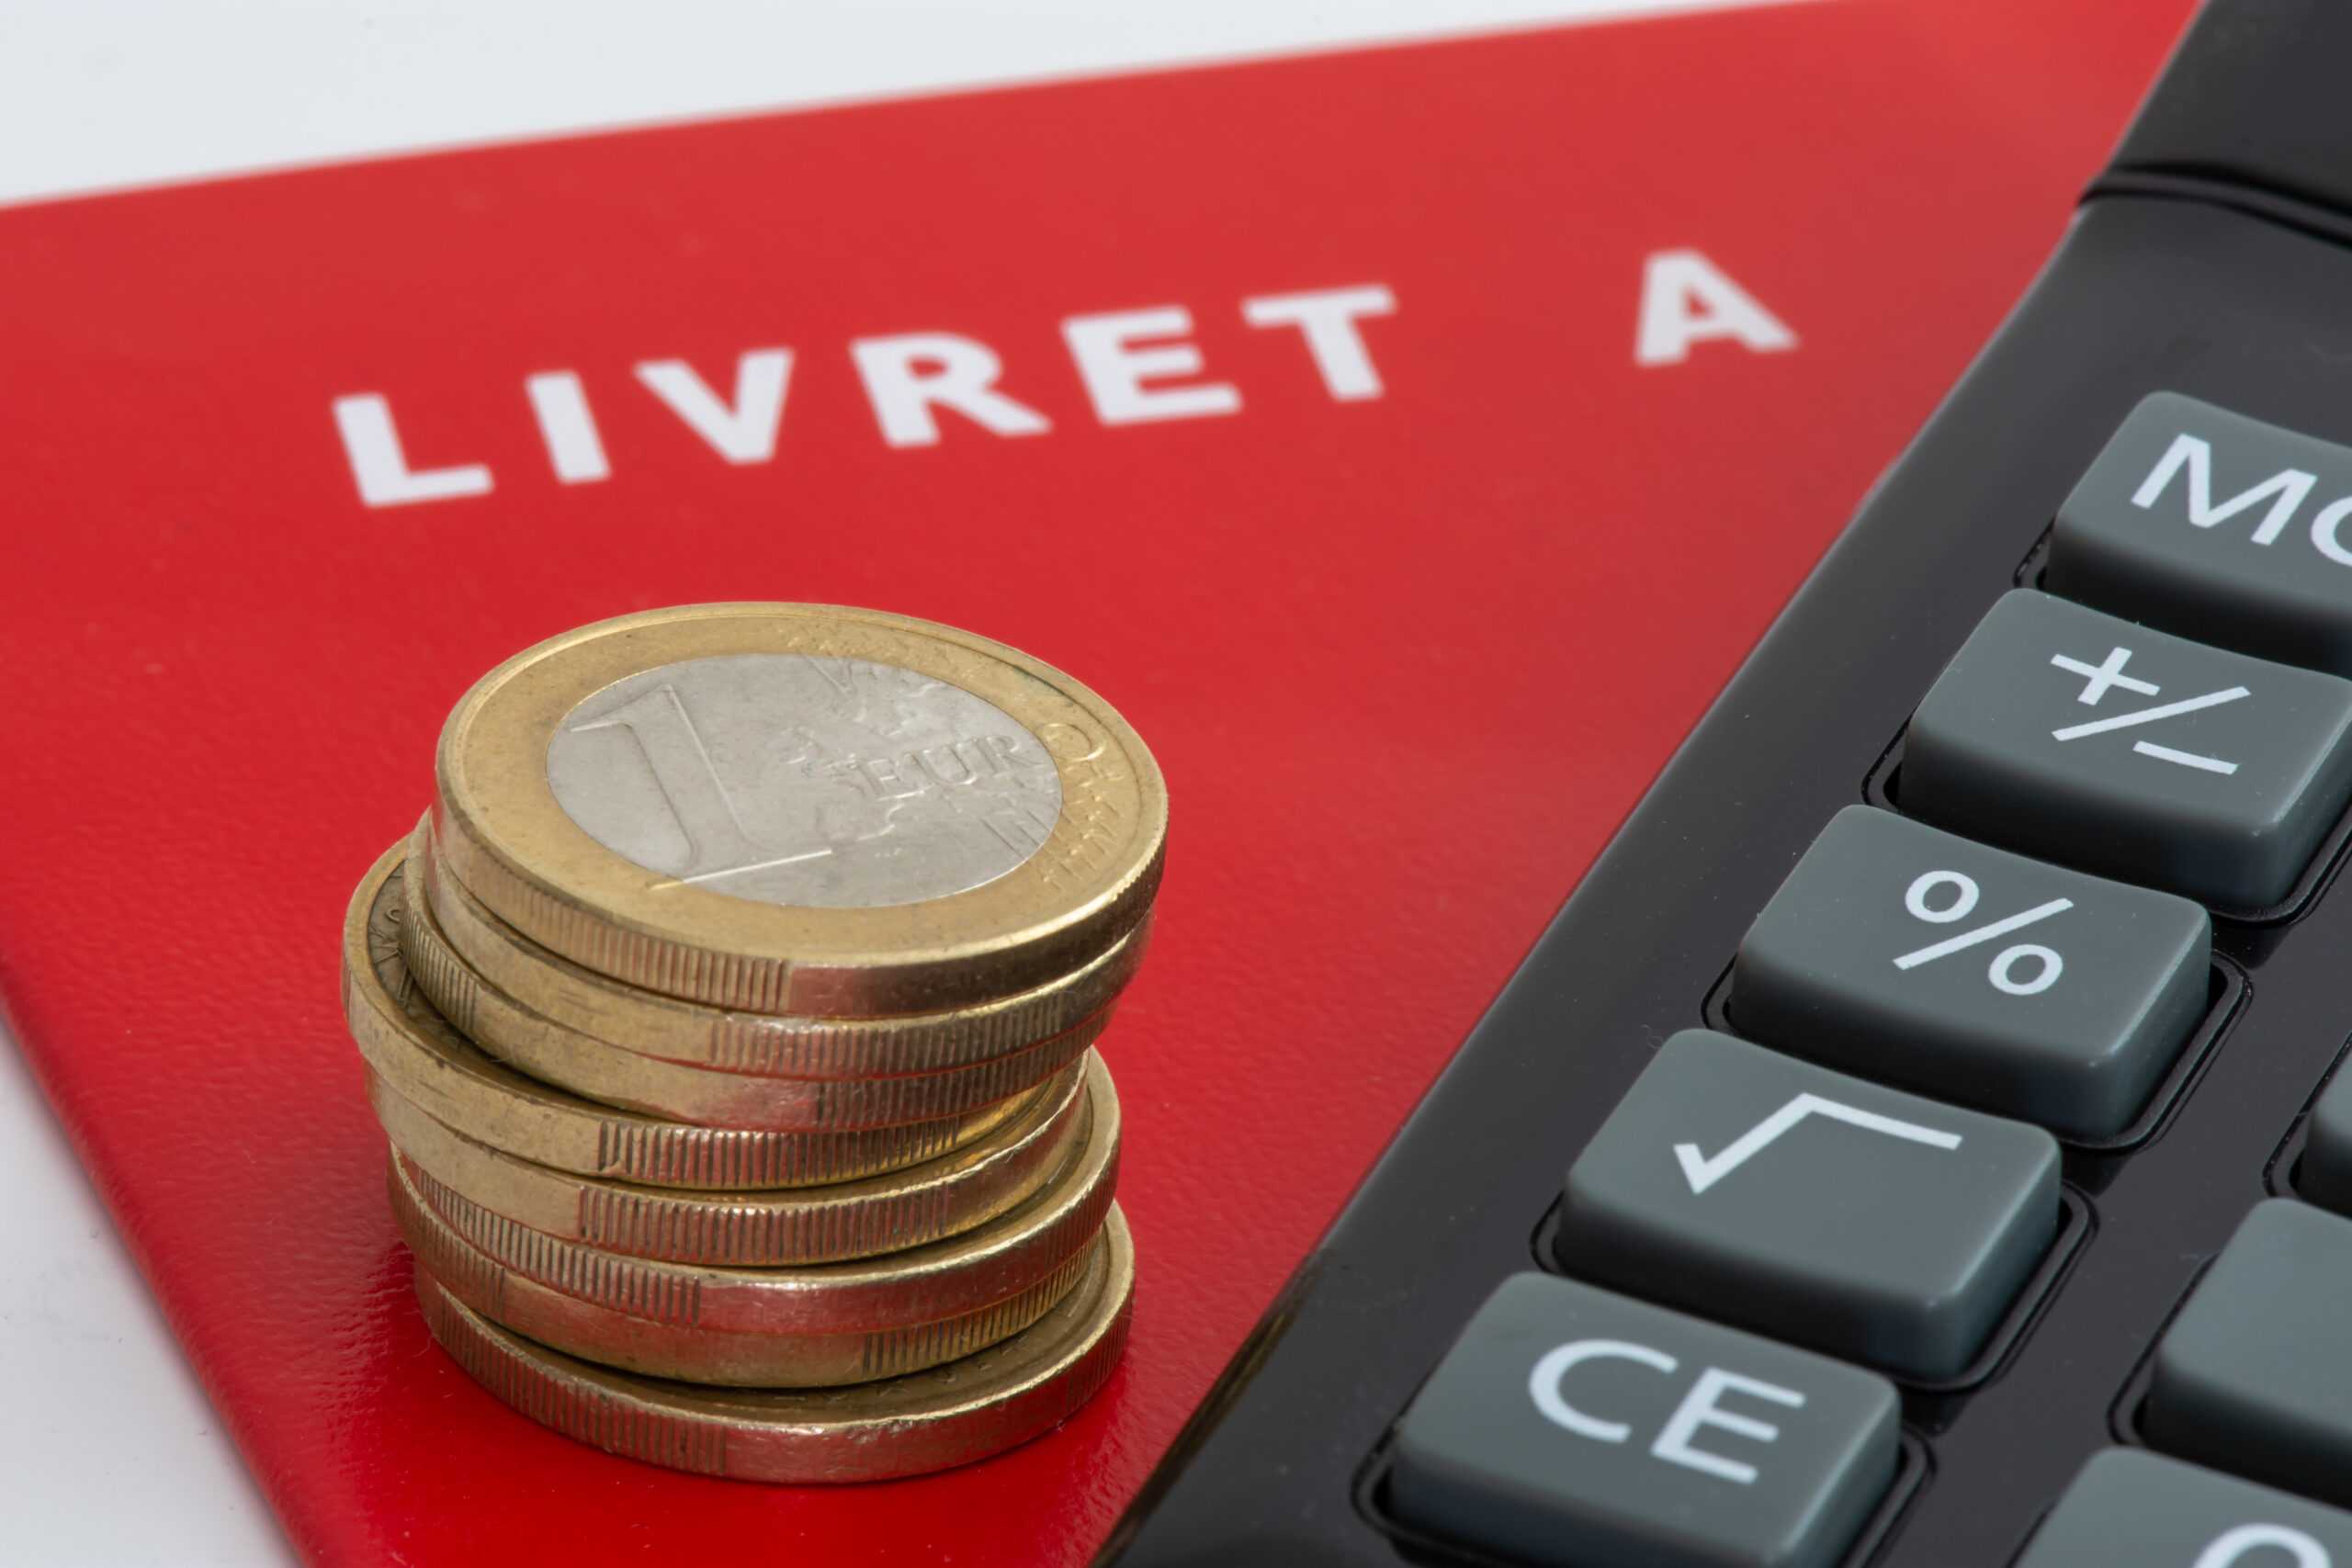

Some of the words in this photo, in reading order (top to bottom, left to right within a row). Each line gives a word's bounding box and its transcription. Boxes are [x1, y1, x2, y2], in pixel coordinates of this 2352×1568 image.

[333, 284, 1396, 509] LIVRET
[1634, 248, 1797, 367] A
[566, 682, 834, 889] 1
[1893, 868, 2075, 998] %
[1529, 1337, 1806, 1485] CE
